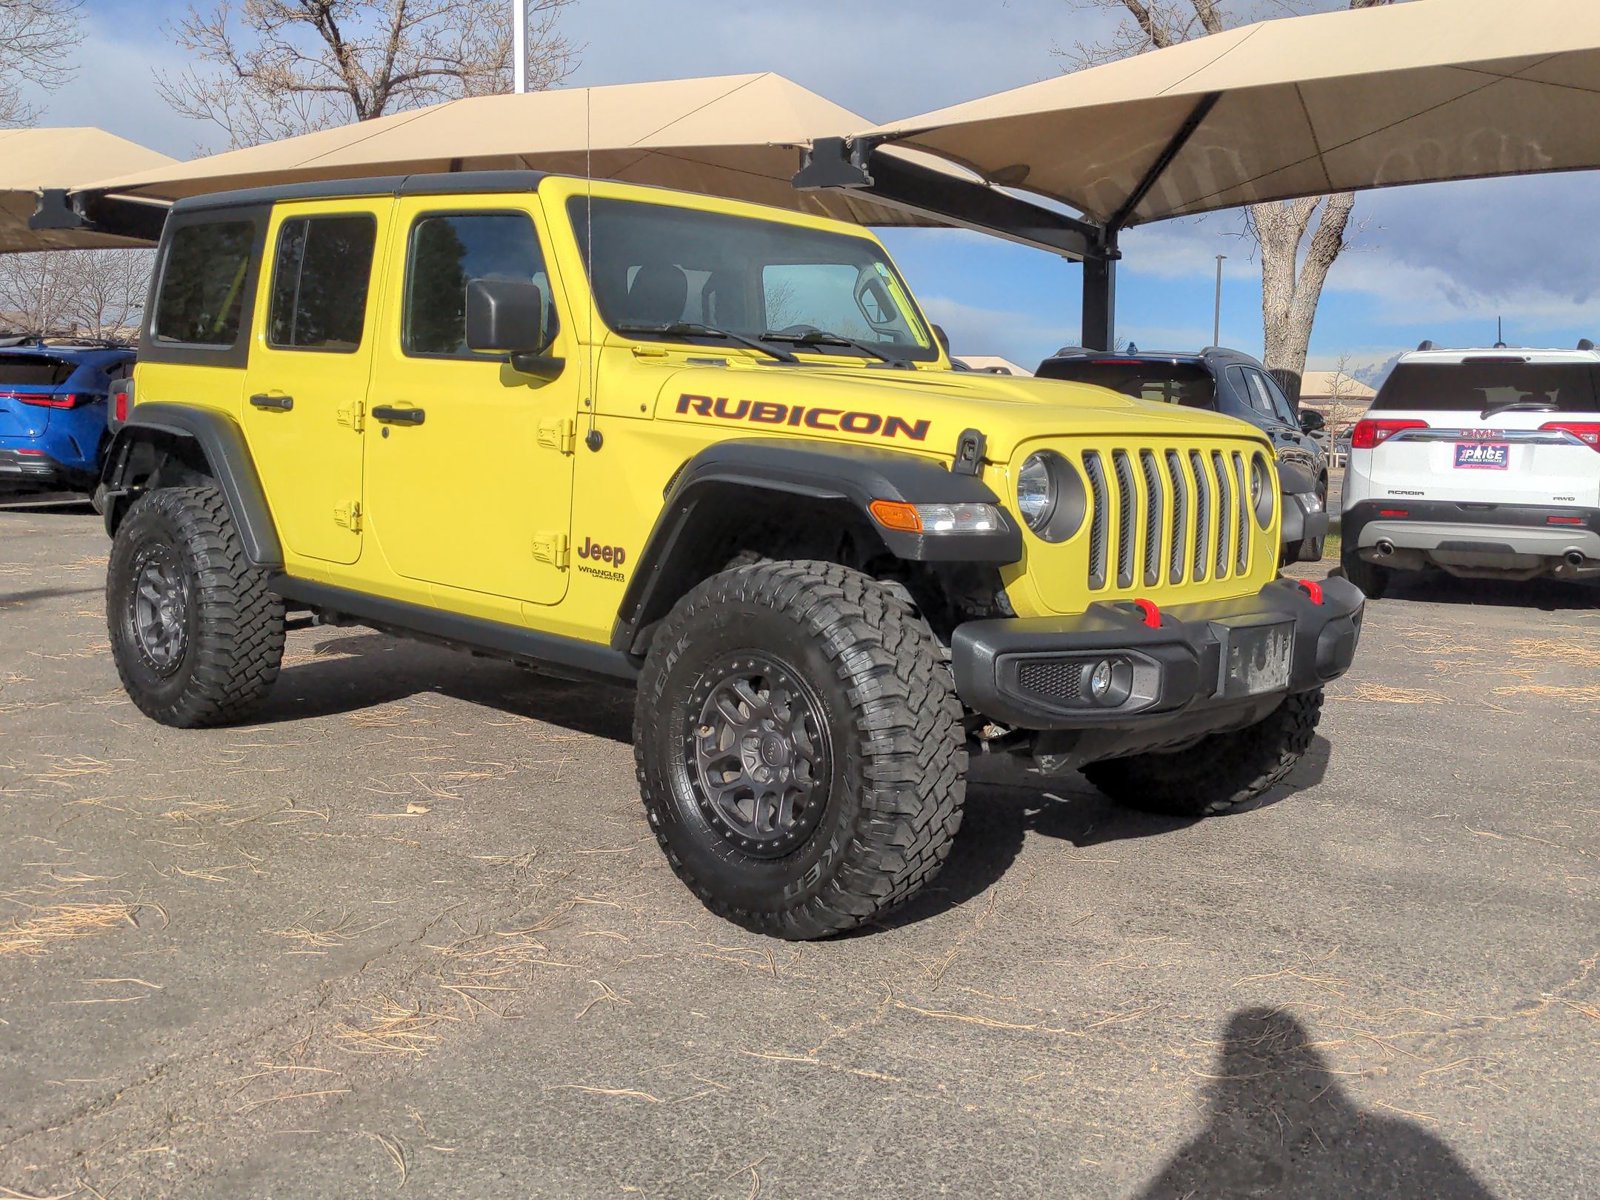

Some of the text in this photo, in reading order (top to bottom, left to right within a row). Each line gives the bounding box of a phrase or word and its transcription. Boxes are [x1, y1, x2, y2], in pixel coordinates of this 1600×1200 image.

[675, 393, 932, 441] RUBICON
[577, 536, 626, 568] Jeep
[577, 564, 625, 580] WRANGLER
